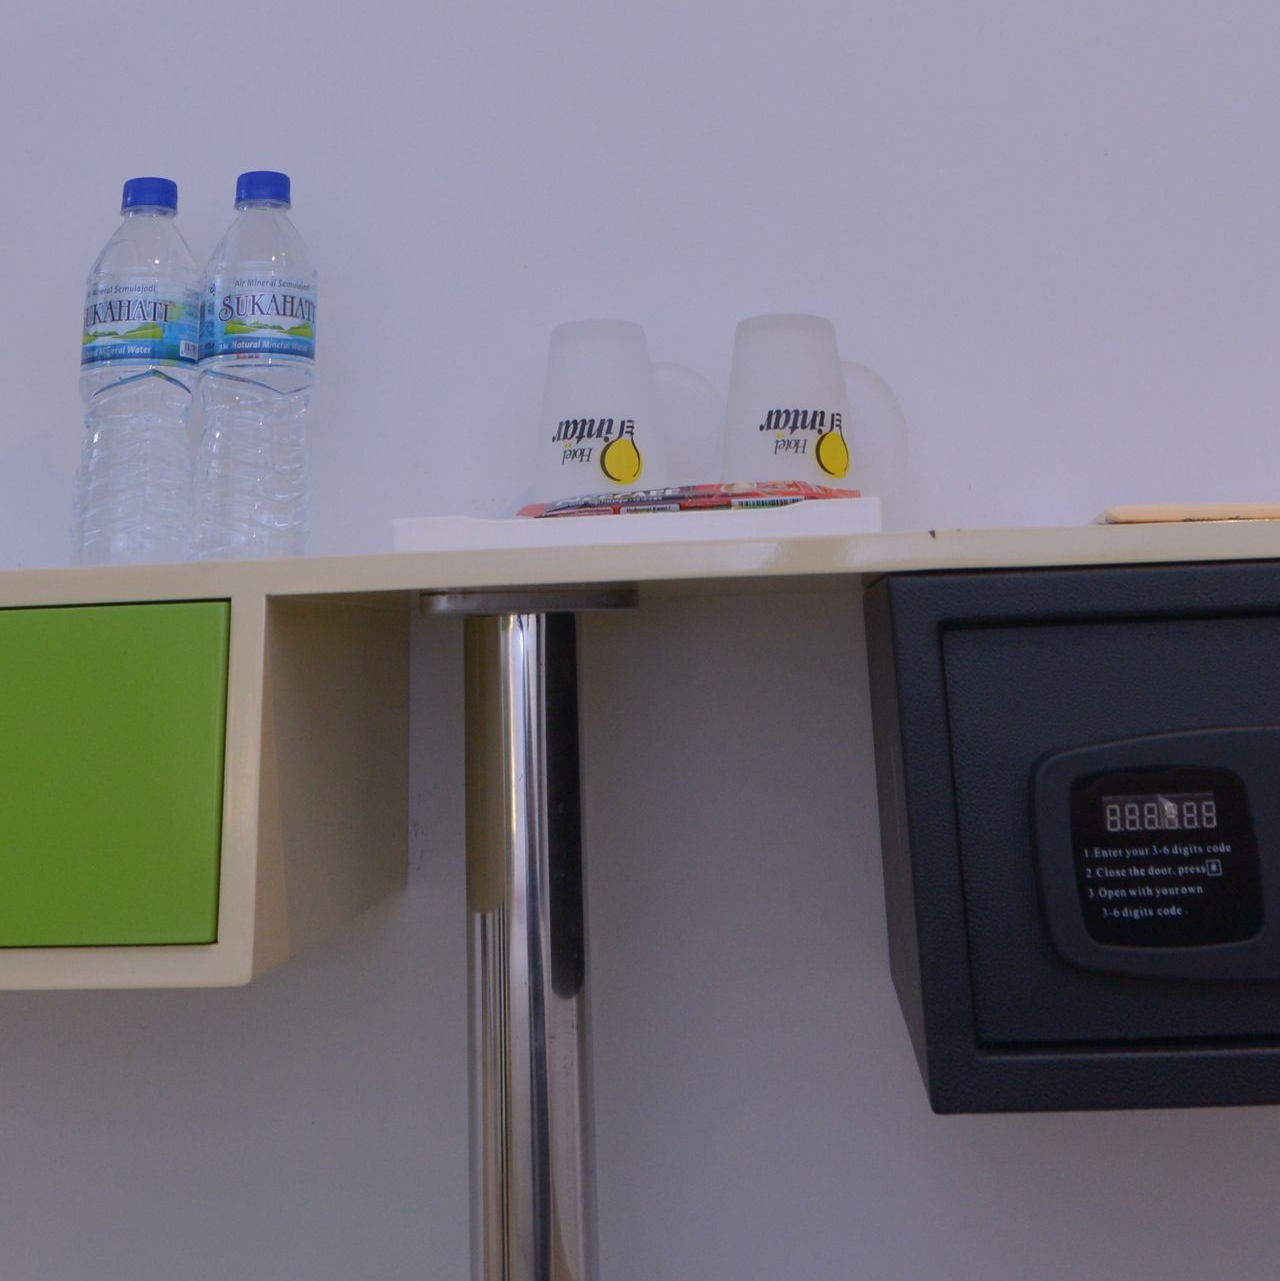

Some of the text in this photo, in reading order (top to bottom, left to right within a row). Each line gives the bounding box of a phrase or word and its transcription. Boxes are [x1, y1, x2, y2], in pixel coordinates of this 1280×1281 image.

[247, 278, 277, 288] Mineral
[84, 300, 172, 327] UKAHATI
[127, 346, 152, 355] Water
[774, 439, 807, 455] Hotel
[562, 448, 592, 465] Hotel
[1125, 847, 1150, 859] your
[1152, 845, 1170, 856] 3-6
[1171, 844, 1203, 858] digits
[1206, 843, 1232, 854] code
[1129, 866, 1146, 877] the
[1178, 866, 1206, 878] press
[1128, 886, 1153, 897] with
[1102, 907, 1120, 918] 3-6
[1121, 906, 1154, 919] digits
